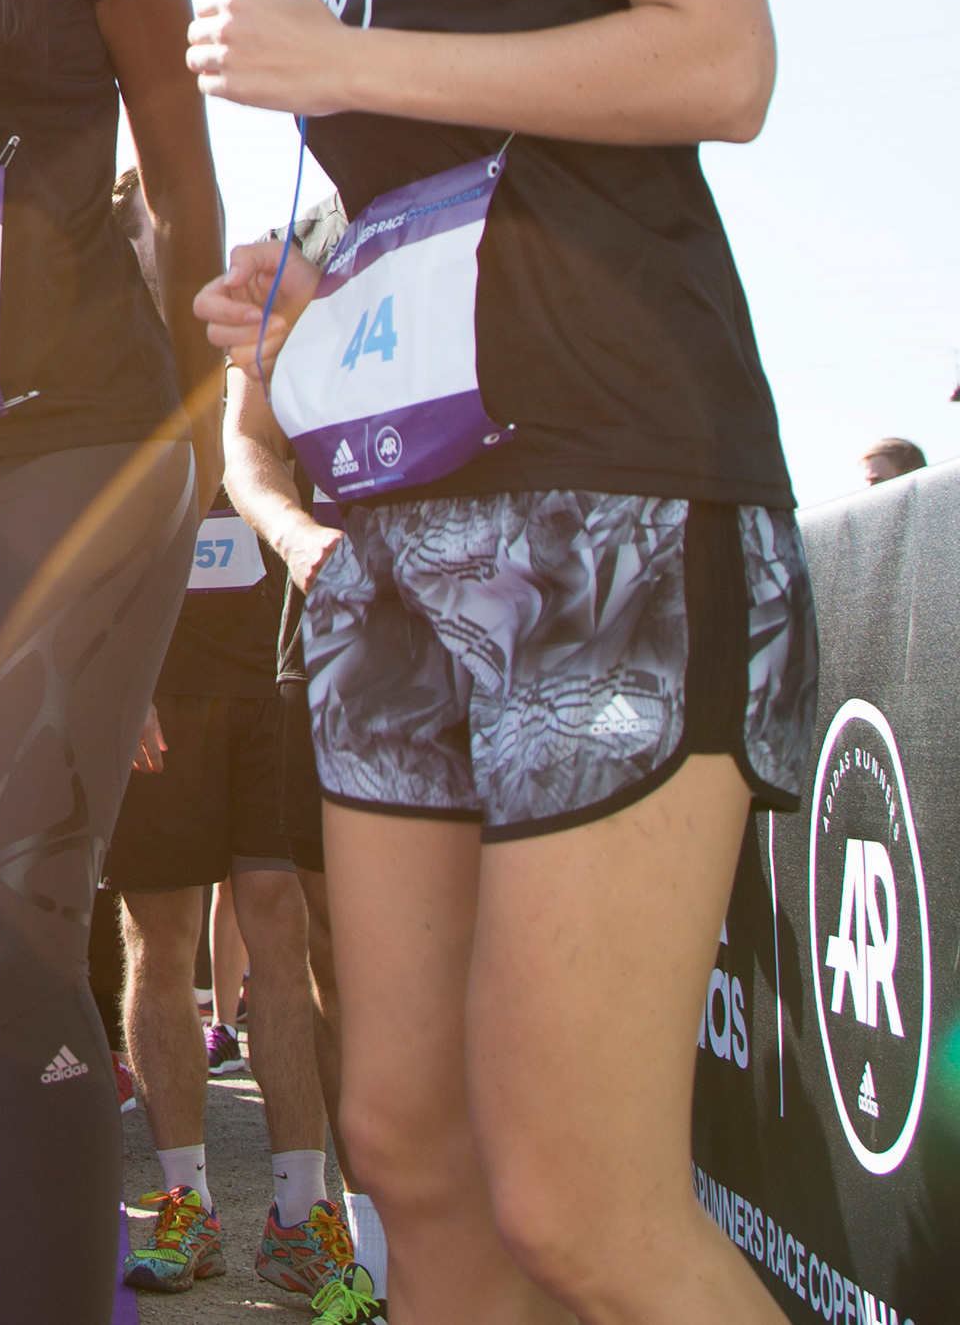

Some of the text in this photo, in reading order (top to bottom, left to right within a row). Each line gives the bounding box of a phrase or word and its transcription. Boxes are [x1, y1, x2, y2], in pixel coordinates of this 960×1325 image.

[377, 212, 407, 235] RACE
[341, 294, 398, 372] 44
[195, 538, 235, 569] 57
[822, 747, 901, 843] ADIDAS RUNNERS
[825, 837, 905, 1038] AR
[40, 1062, 90, 1084] adidas
[697, 1166, 764, 1262] RUNNERS
[766, 1215, 806, 1301] RACE
